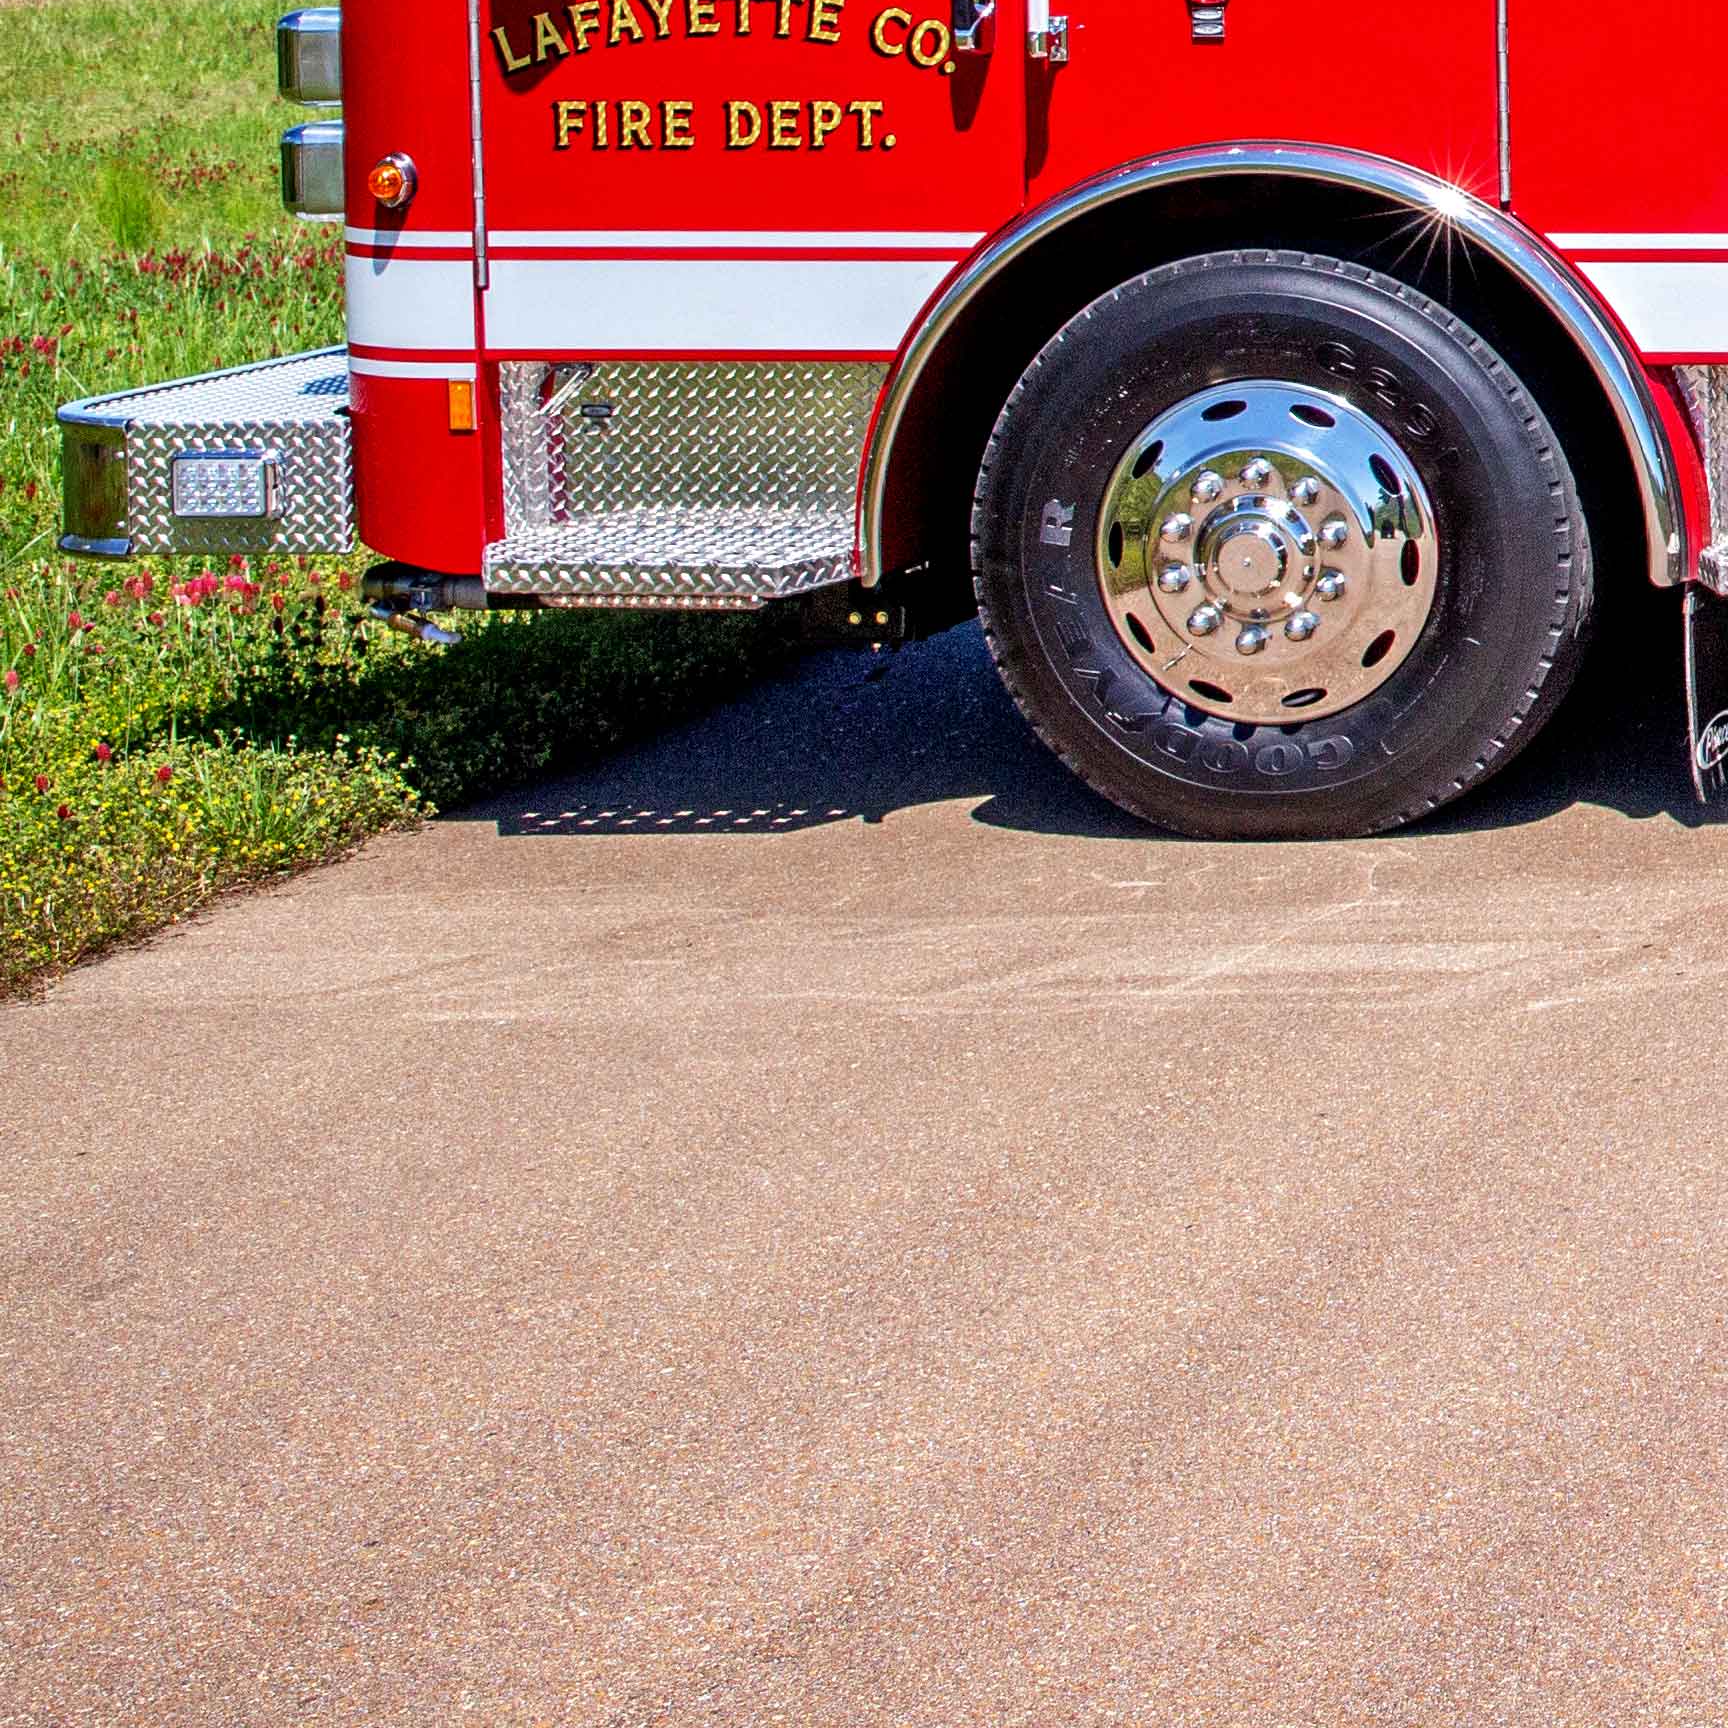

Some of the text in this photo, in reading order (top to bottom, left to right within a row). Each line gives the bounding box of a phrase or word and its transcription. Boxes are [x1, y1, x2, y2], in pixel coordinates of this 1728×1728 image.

[870, 6, 956, 74] CO.
[554, 100, 898, 149] FIRE DEPT.
[1038, 498, 1354, 776] GOODYEAR
